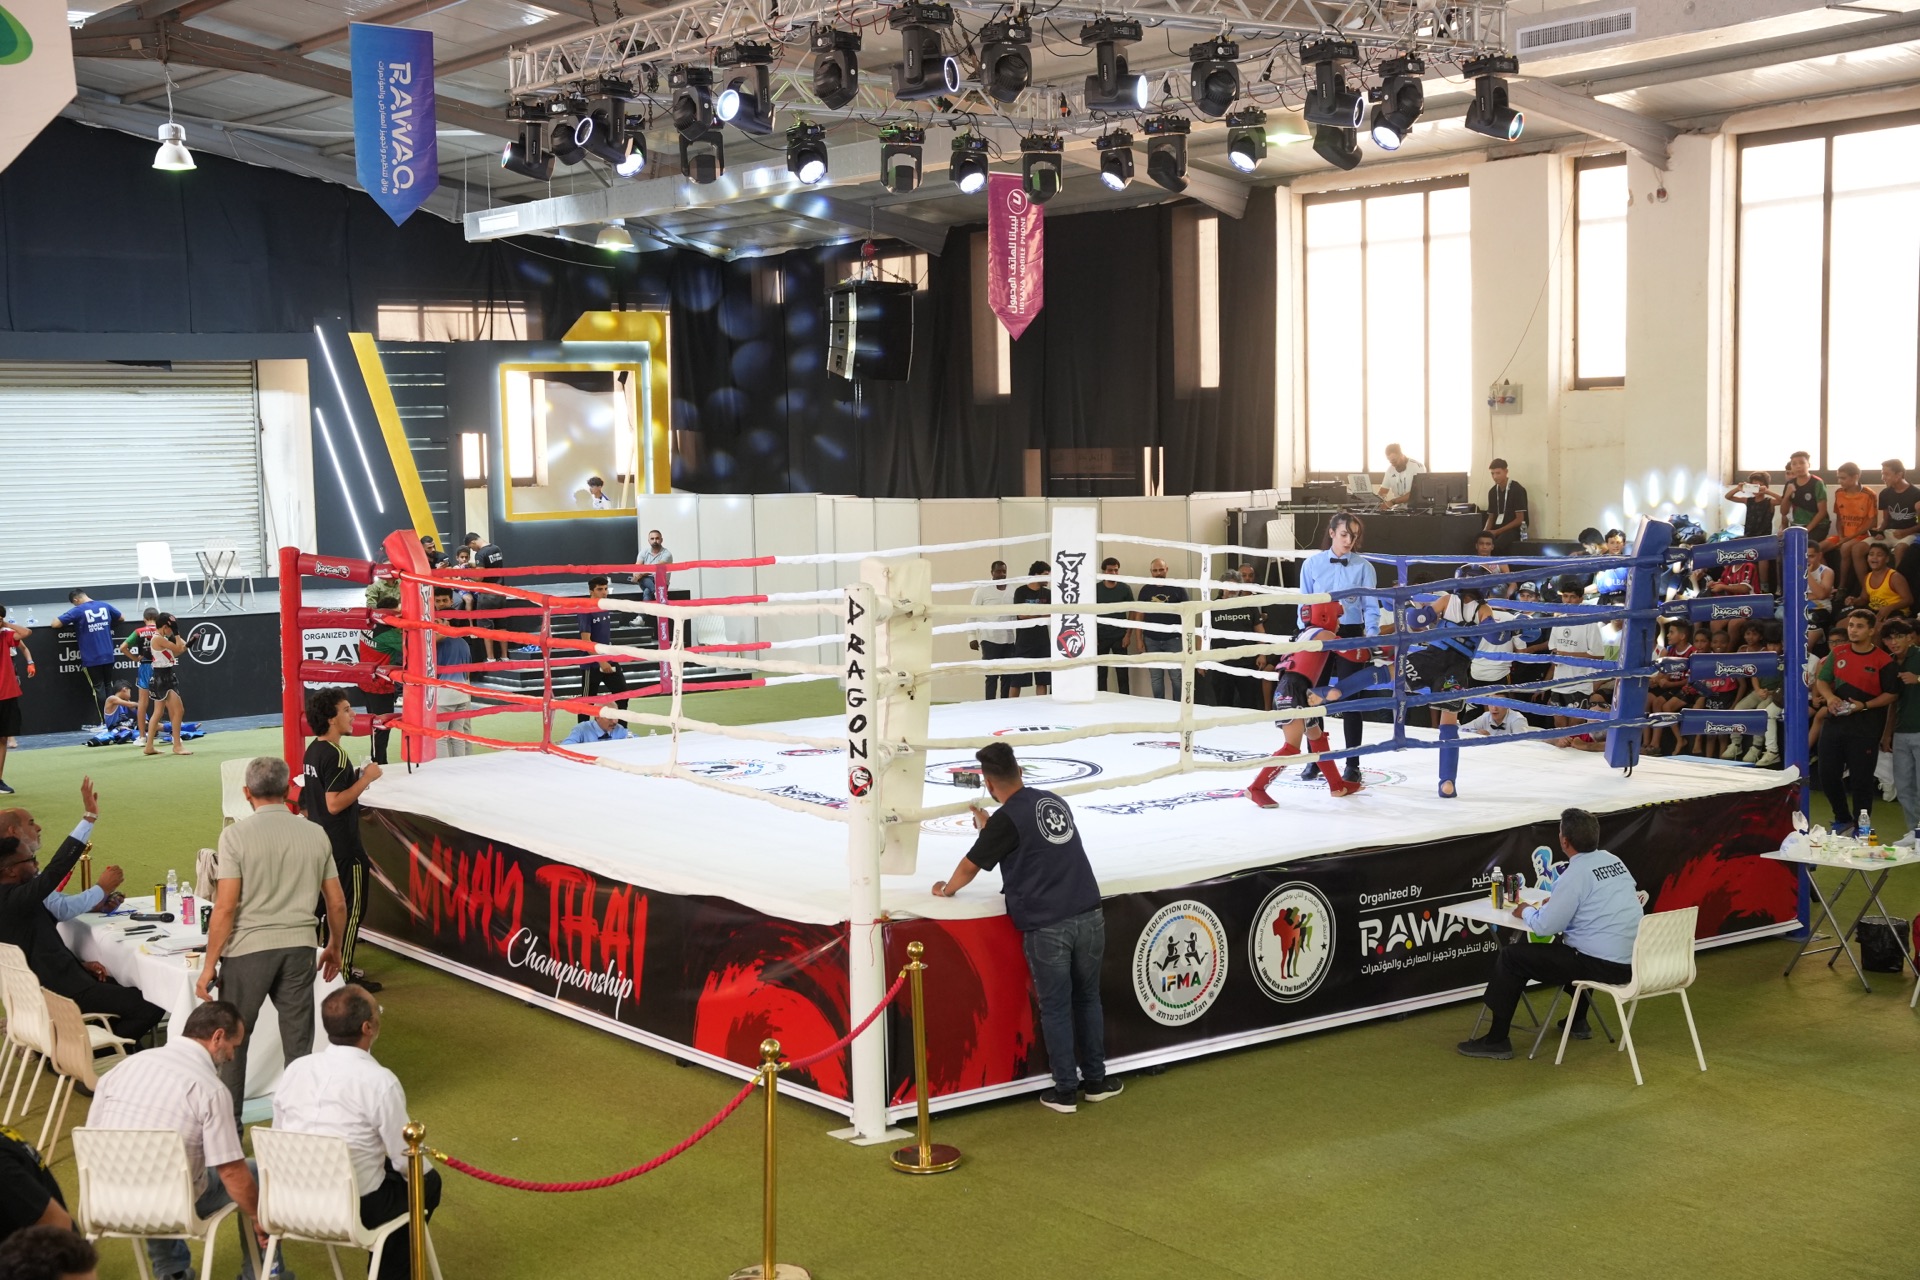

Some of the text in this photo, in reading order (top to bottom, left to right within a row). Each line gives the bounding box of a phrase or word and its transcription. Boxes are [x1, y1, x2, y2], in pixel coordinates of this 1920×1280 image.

[388, 62, 415, 195] RAWAQ
[1007, 242, 1017, 274] للهاتف
[1717, 549, 1747, 564] DRAGON
[1214, 613, 1251, 622] uhlsport
[1711, 604, 1741, 618] DRAGON
[304, 631, 347, 640] ORGANIZED
[59, 664, 81, 673] LIBY
[847, 596, 868, 759] DRAGON
[1715, 662, 1745, 676] DRAGON
[1592, 862, 1627, 882] REFEREE
[1359, 885, 1422, 906] Organized By
[409, 834, 648, 1005] MUAY THAI
[1136, 903, 1225, 1002] INTERNATIONAL FEDERATION OF MUAYTHAI ASSOCIATIONS
[1361, 941, 1498, 975] رواق لتنظيم وتجهيز المعارض والمؤتمرات
[507, 926, 633, 1020] Championship
[1306, 956, 1325, 983] Federation
[1161, 971, 1202, 992] IFMA
